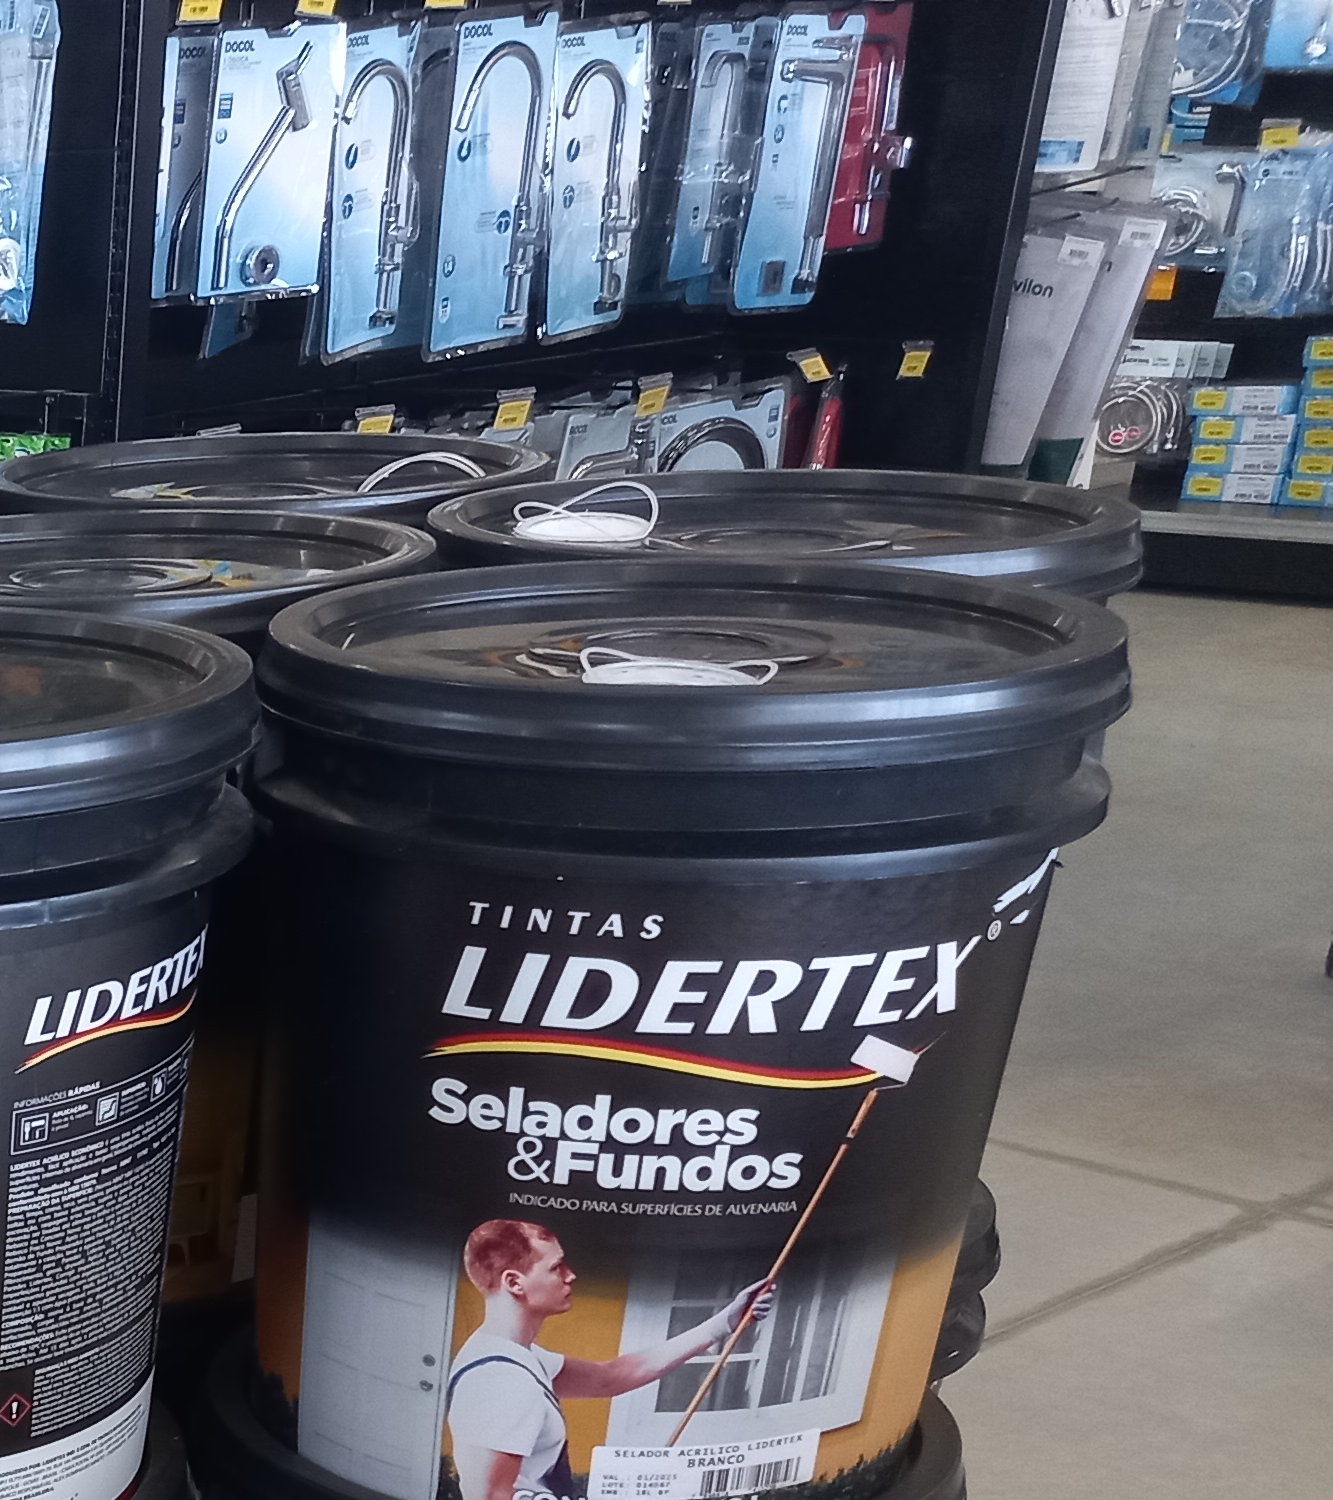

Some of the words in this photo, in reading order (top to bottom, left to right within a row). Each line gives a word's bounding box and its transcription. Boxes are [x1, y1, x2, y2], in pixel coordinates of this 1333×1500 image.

[464, 24, 493, 39] DOCOL
[561, 35, 586, 48] DOCOL
[225, 41, 255, 53] DOCOL
[468, 901, 665, 940] TINTAS
[441, 934, 983, 1036] LIDERTEX
[13, 1091, 67, 1109] INFORMAÇÕES
[68, 1081, 101, 1097] RÁPIDAS
[428, 1076, 760, 1147] Seladores
[509, 1193, 579, 1210] INDICADO
[582, 1200, 617, 1213] PARA
[620, 1202, 702, 1216] SUPERFÍCIES
[705, 1204, 723, 1216] DE
[725, 1201, 797, 1215] ALVENARIA
[614, 1450, 670, 1458] SELADOR
[678, 1445, 740, 1457] ACRILICO
[747, 1435, 803, 1451] LIDERTEX
[687, 1454, 745, 1468] BRANCO
